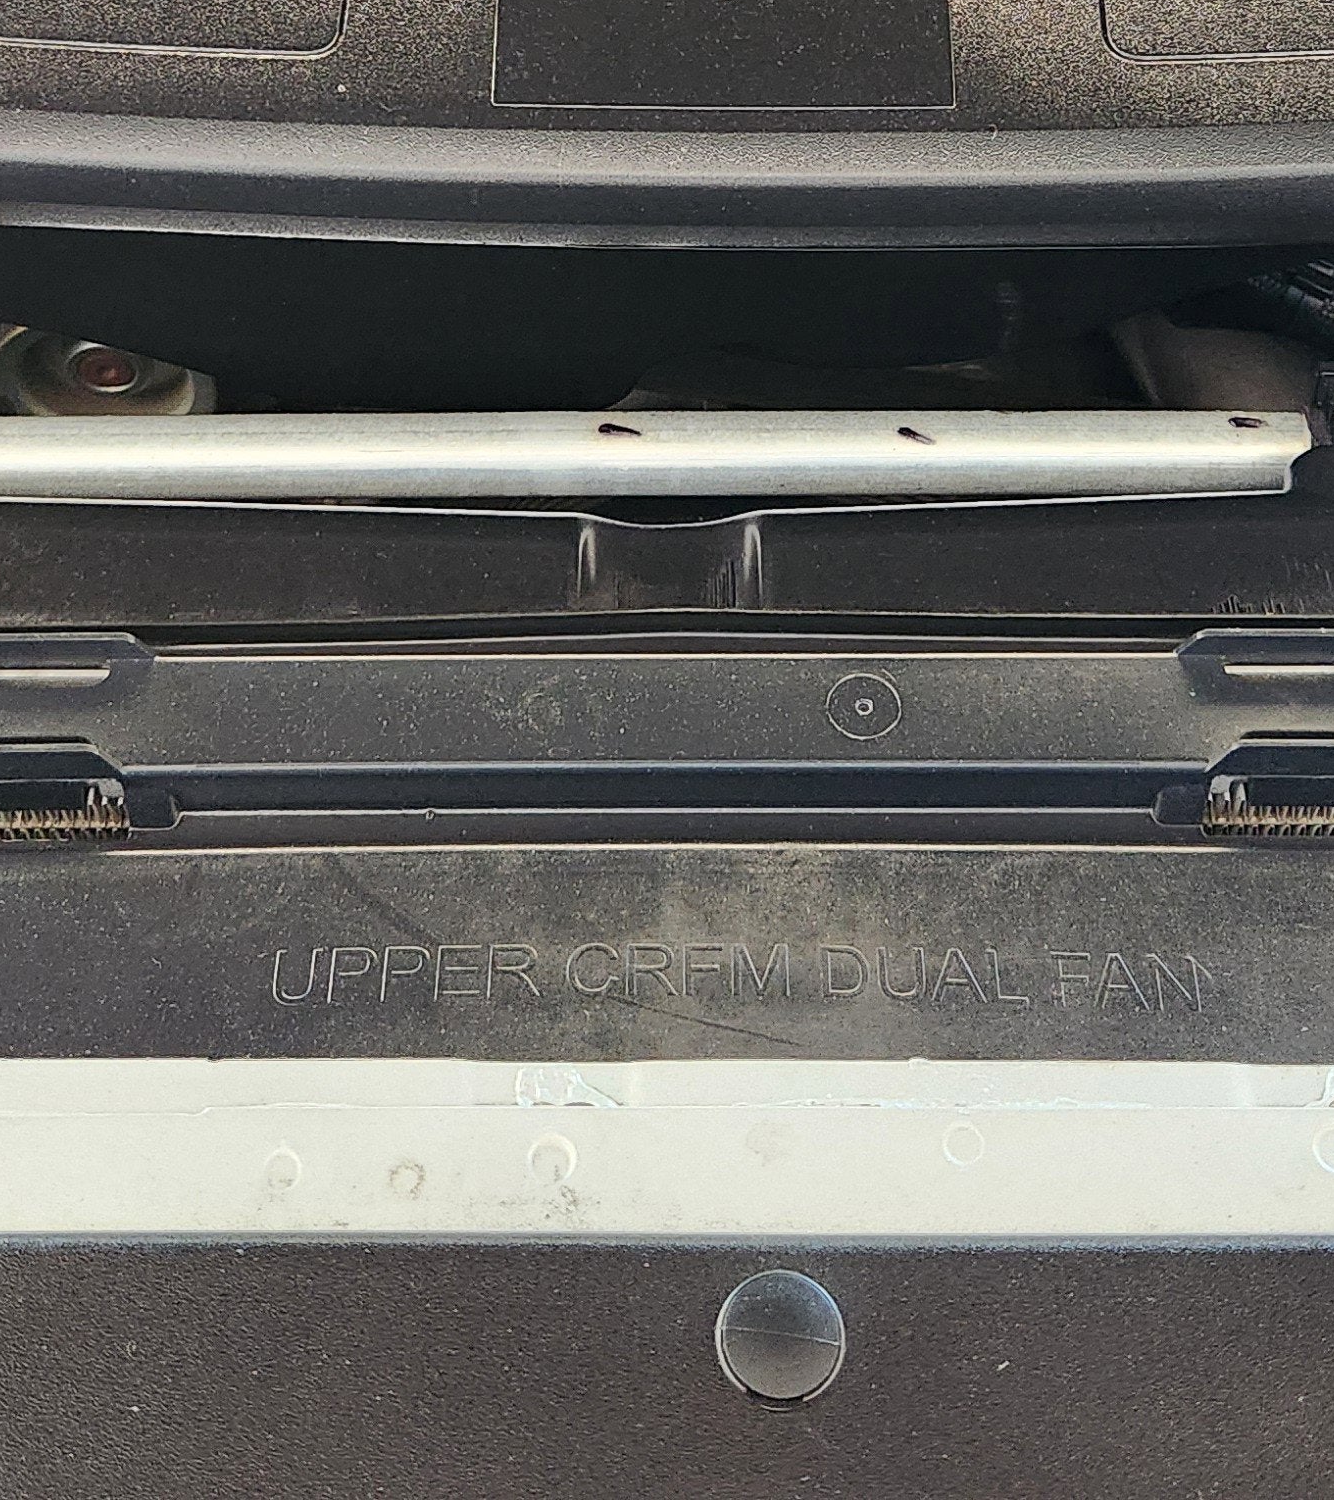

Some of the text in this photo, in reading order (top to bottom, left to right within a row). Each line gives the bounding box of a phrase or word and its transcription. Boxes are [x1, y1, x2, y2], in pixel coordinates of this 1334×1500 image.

[271, 942, 1214, 1013] UPPER CRFM DUAL FAN
